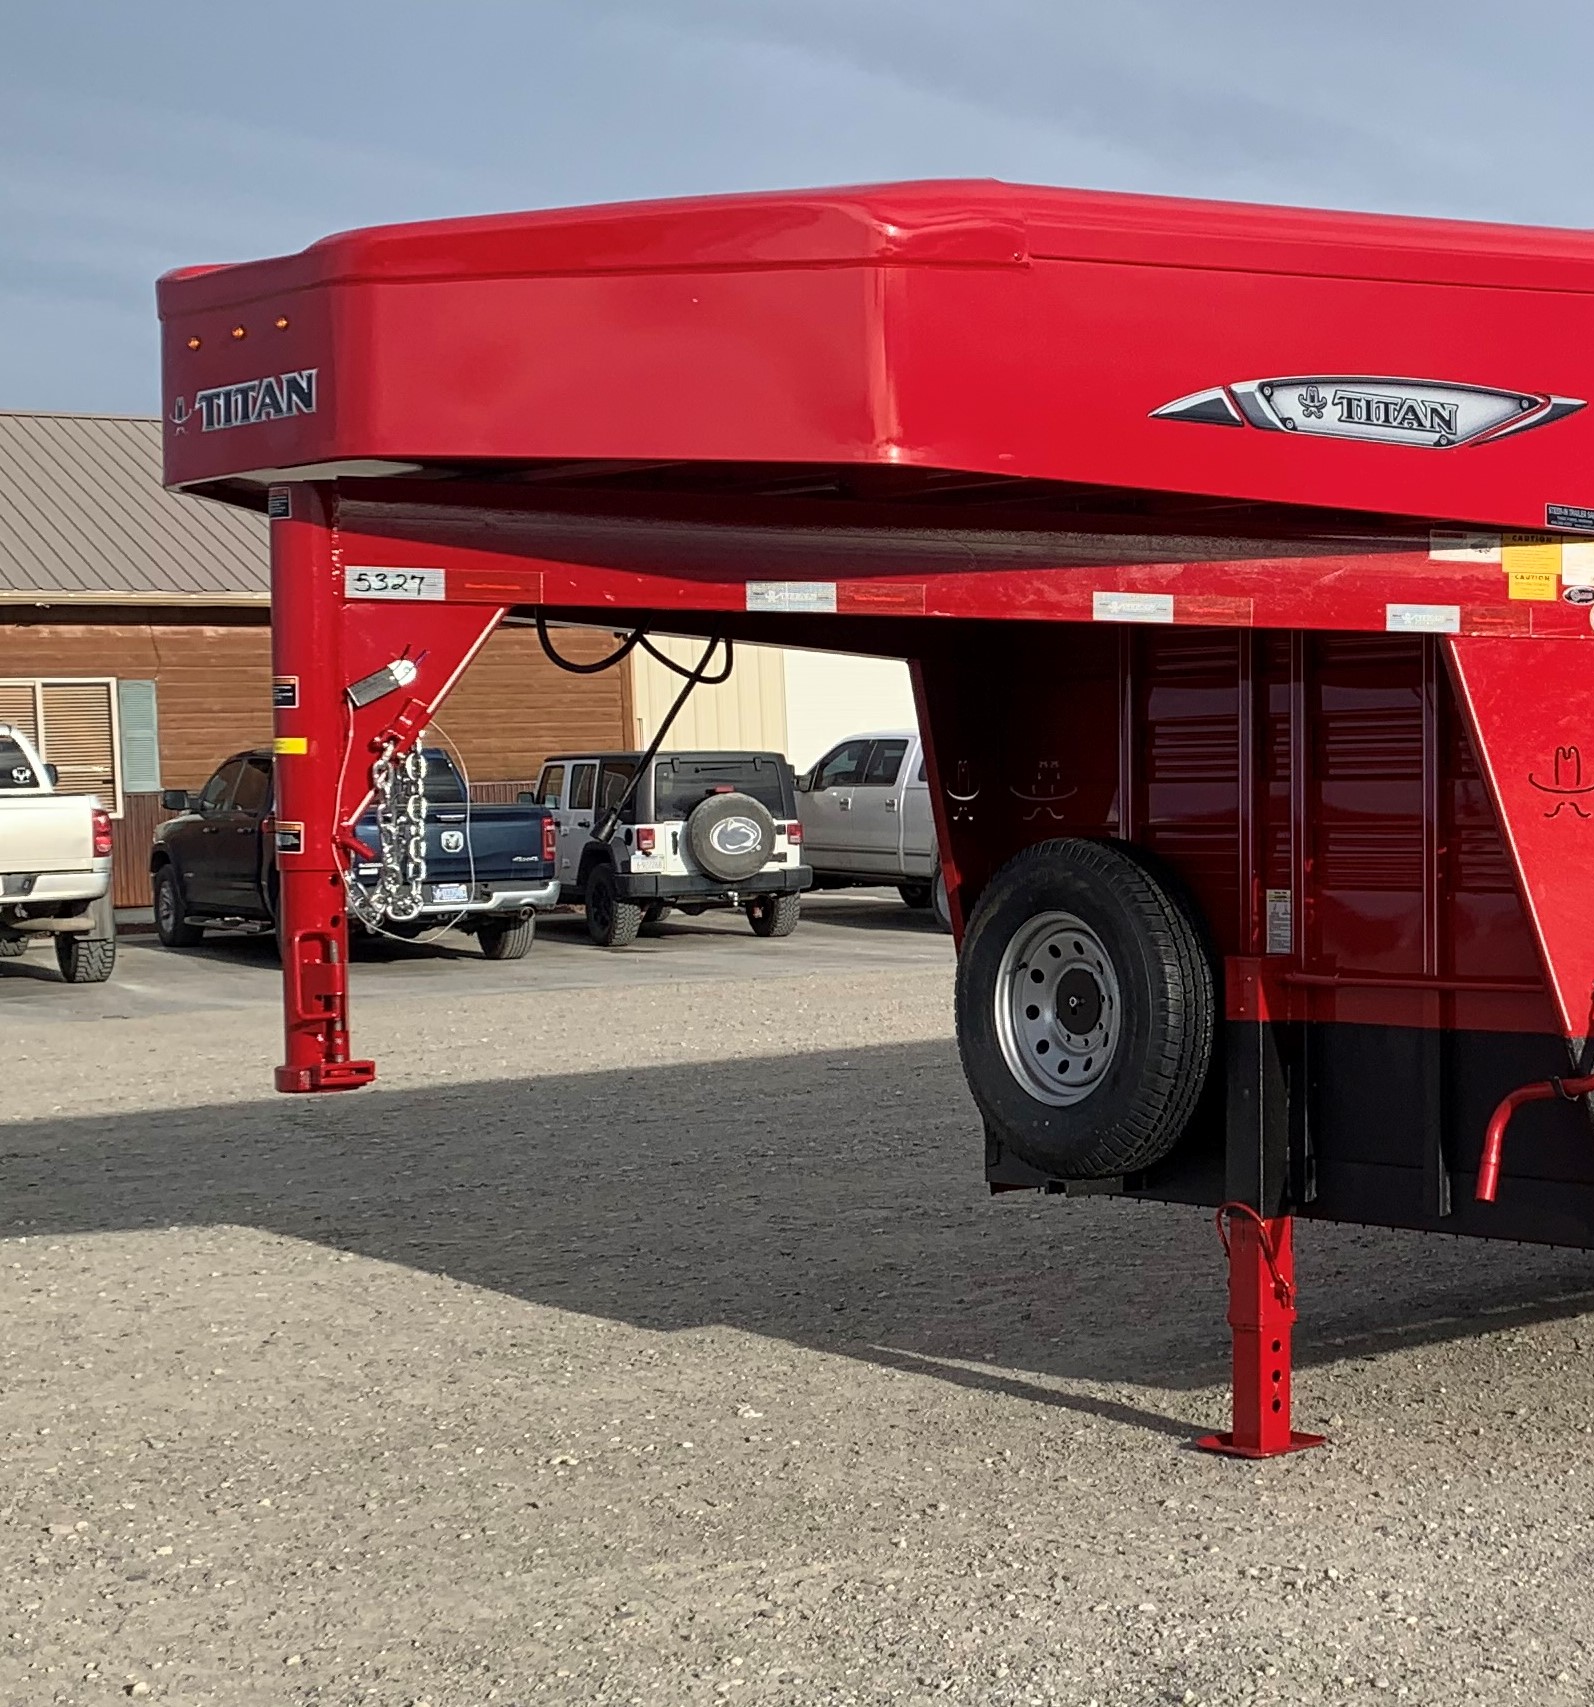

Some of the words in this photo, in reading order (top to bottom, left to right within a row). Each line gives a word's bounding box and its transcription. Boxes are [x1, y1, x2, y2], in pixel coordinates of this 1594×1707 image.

[195, 368, 318, 432] TITAN
[1332, 389, 1459, 435] TITAN
[1512, 533, 1552, 543] CAUTION
[353, 573, 425, 595] 5327
[1514, 574, 1551, 582] CAUTION
